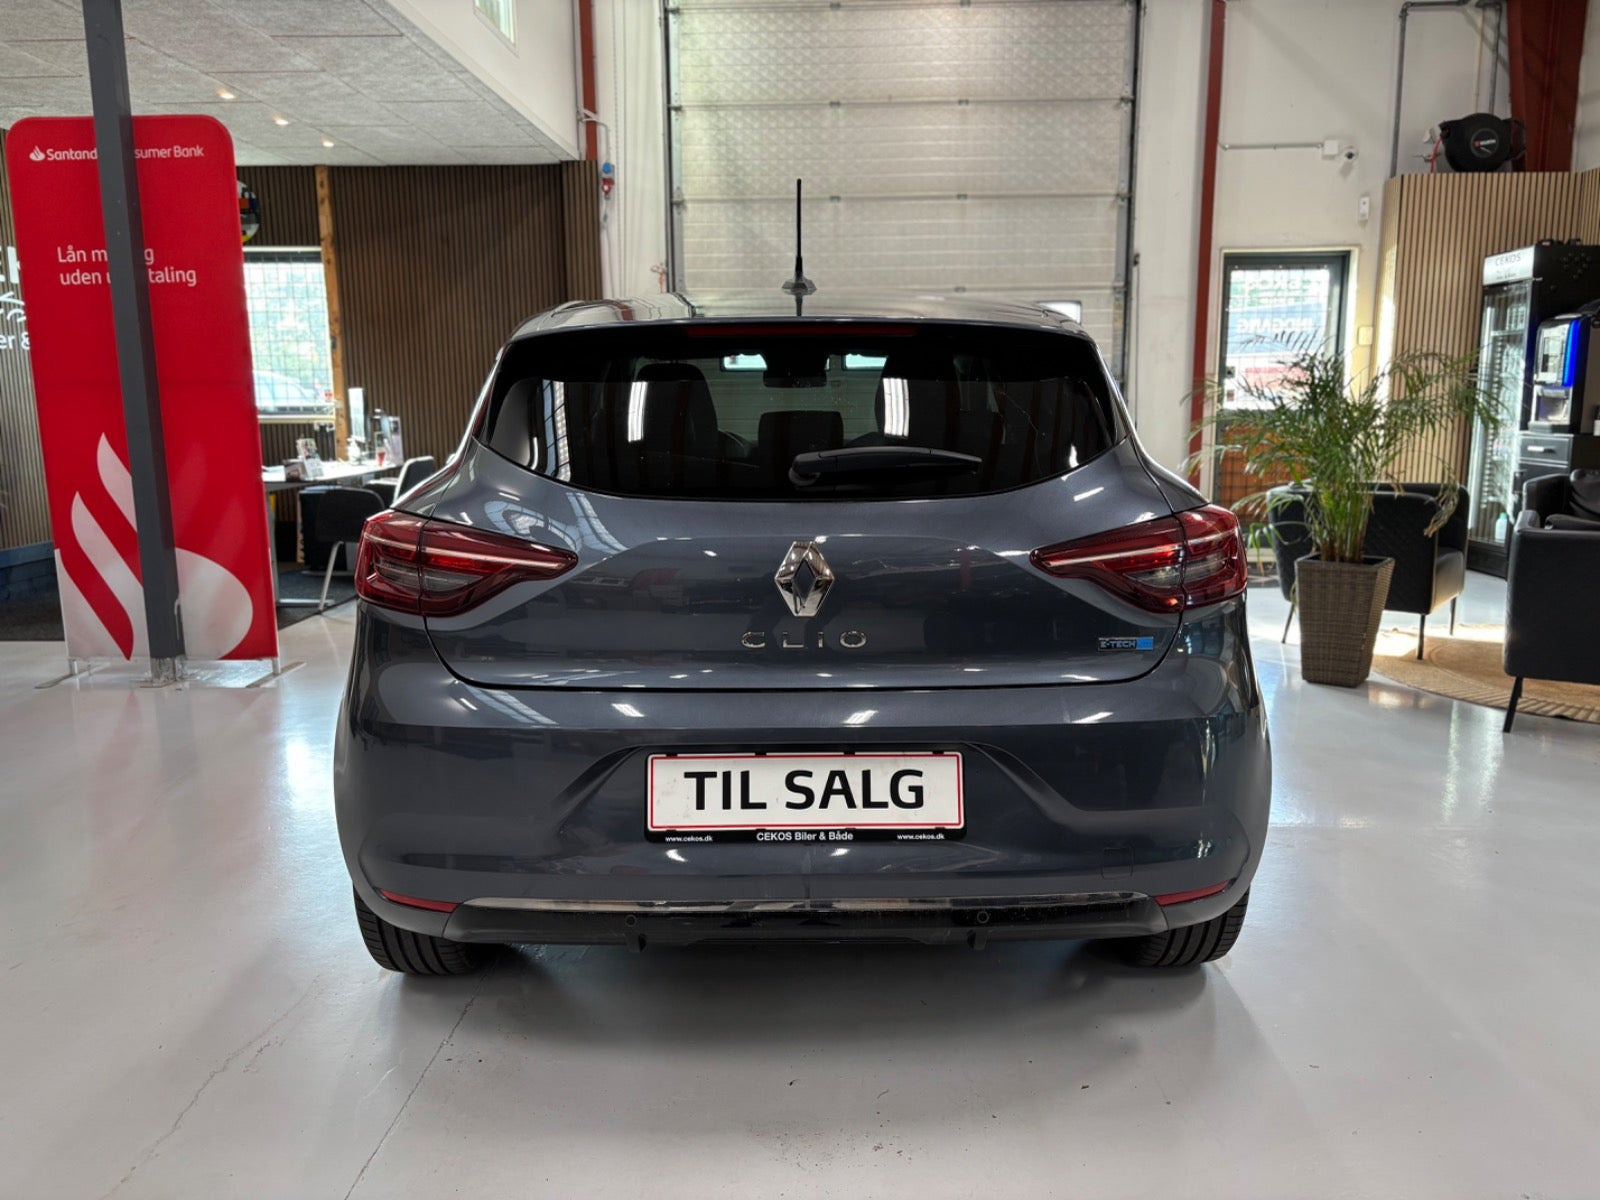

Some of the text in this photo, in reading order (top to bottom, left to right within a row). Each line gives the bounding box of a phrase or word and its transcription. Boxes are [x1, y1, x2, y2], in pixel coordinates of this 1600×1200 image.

[46, 145, 204, 161] Santand sumer Bank
[57, 245, 87, 263] Lån
[60, 268, 102, 286] uden
[741, 630, 867, 648] CLIO
[1100, 640, 1136, 649] E-TECH
[683, 768, 925, 811] TIL SALG
[664, 835, 714, 843] www.cekos.dk
[756, 830, 854, 841] CEKOS Biler & Både
[896, 833, 945, 841] www.cekos.dk
